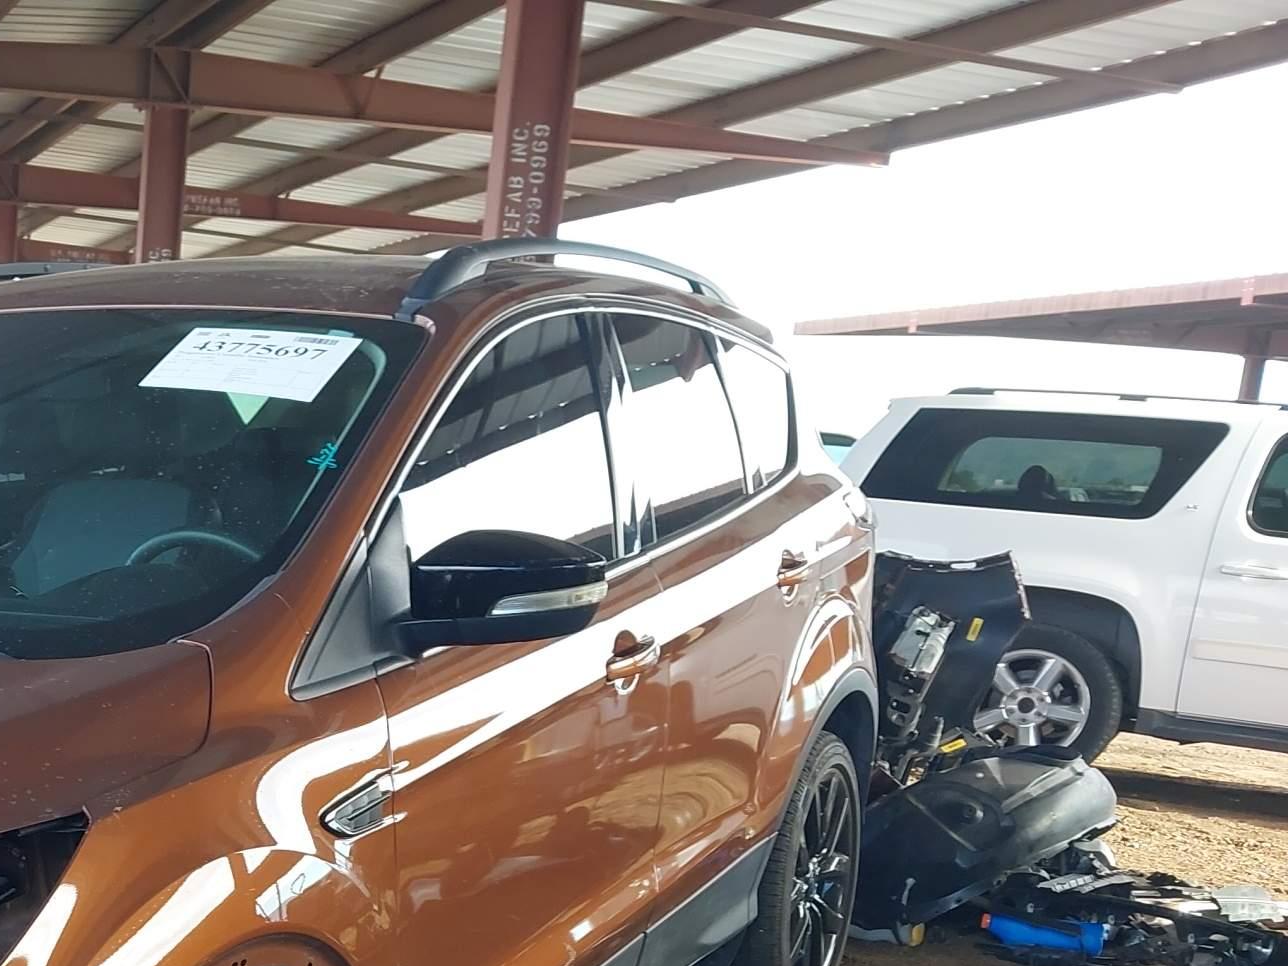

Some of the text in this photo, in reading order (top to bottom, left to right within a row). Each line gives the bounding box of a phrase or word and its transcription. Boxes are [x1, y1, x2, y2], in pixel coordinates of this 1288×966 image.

[501, 121, 531, 239] EFAB INC.
[192, 341, 329, 360] 43775697
